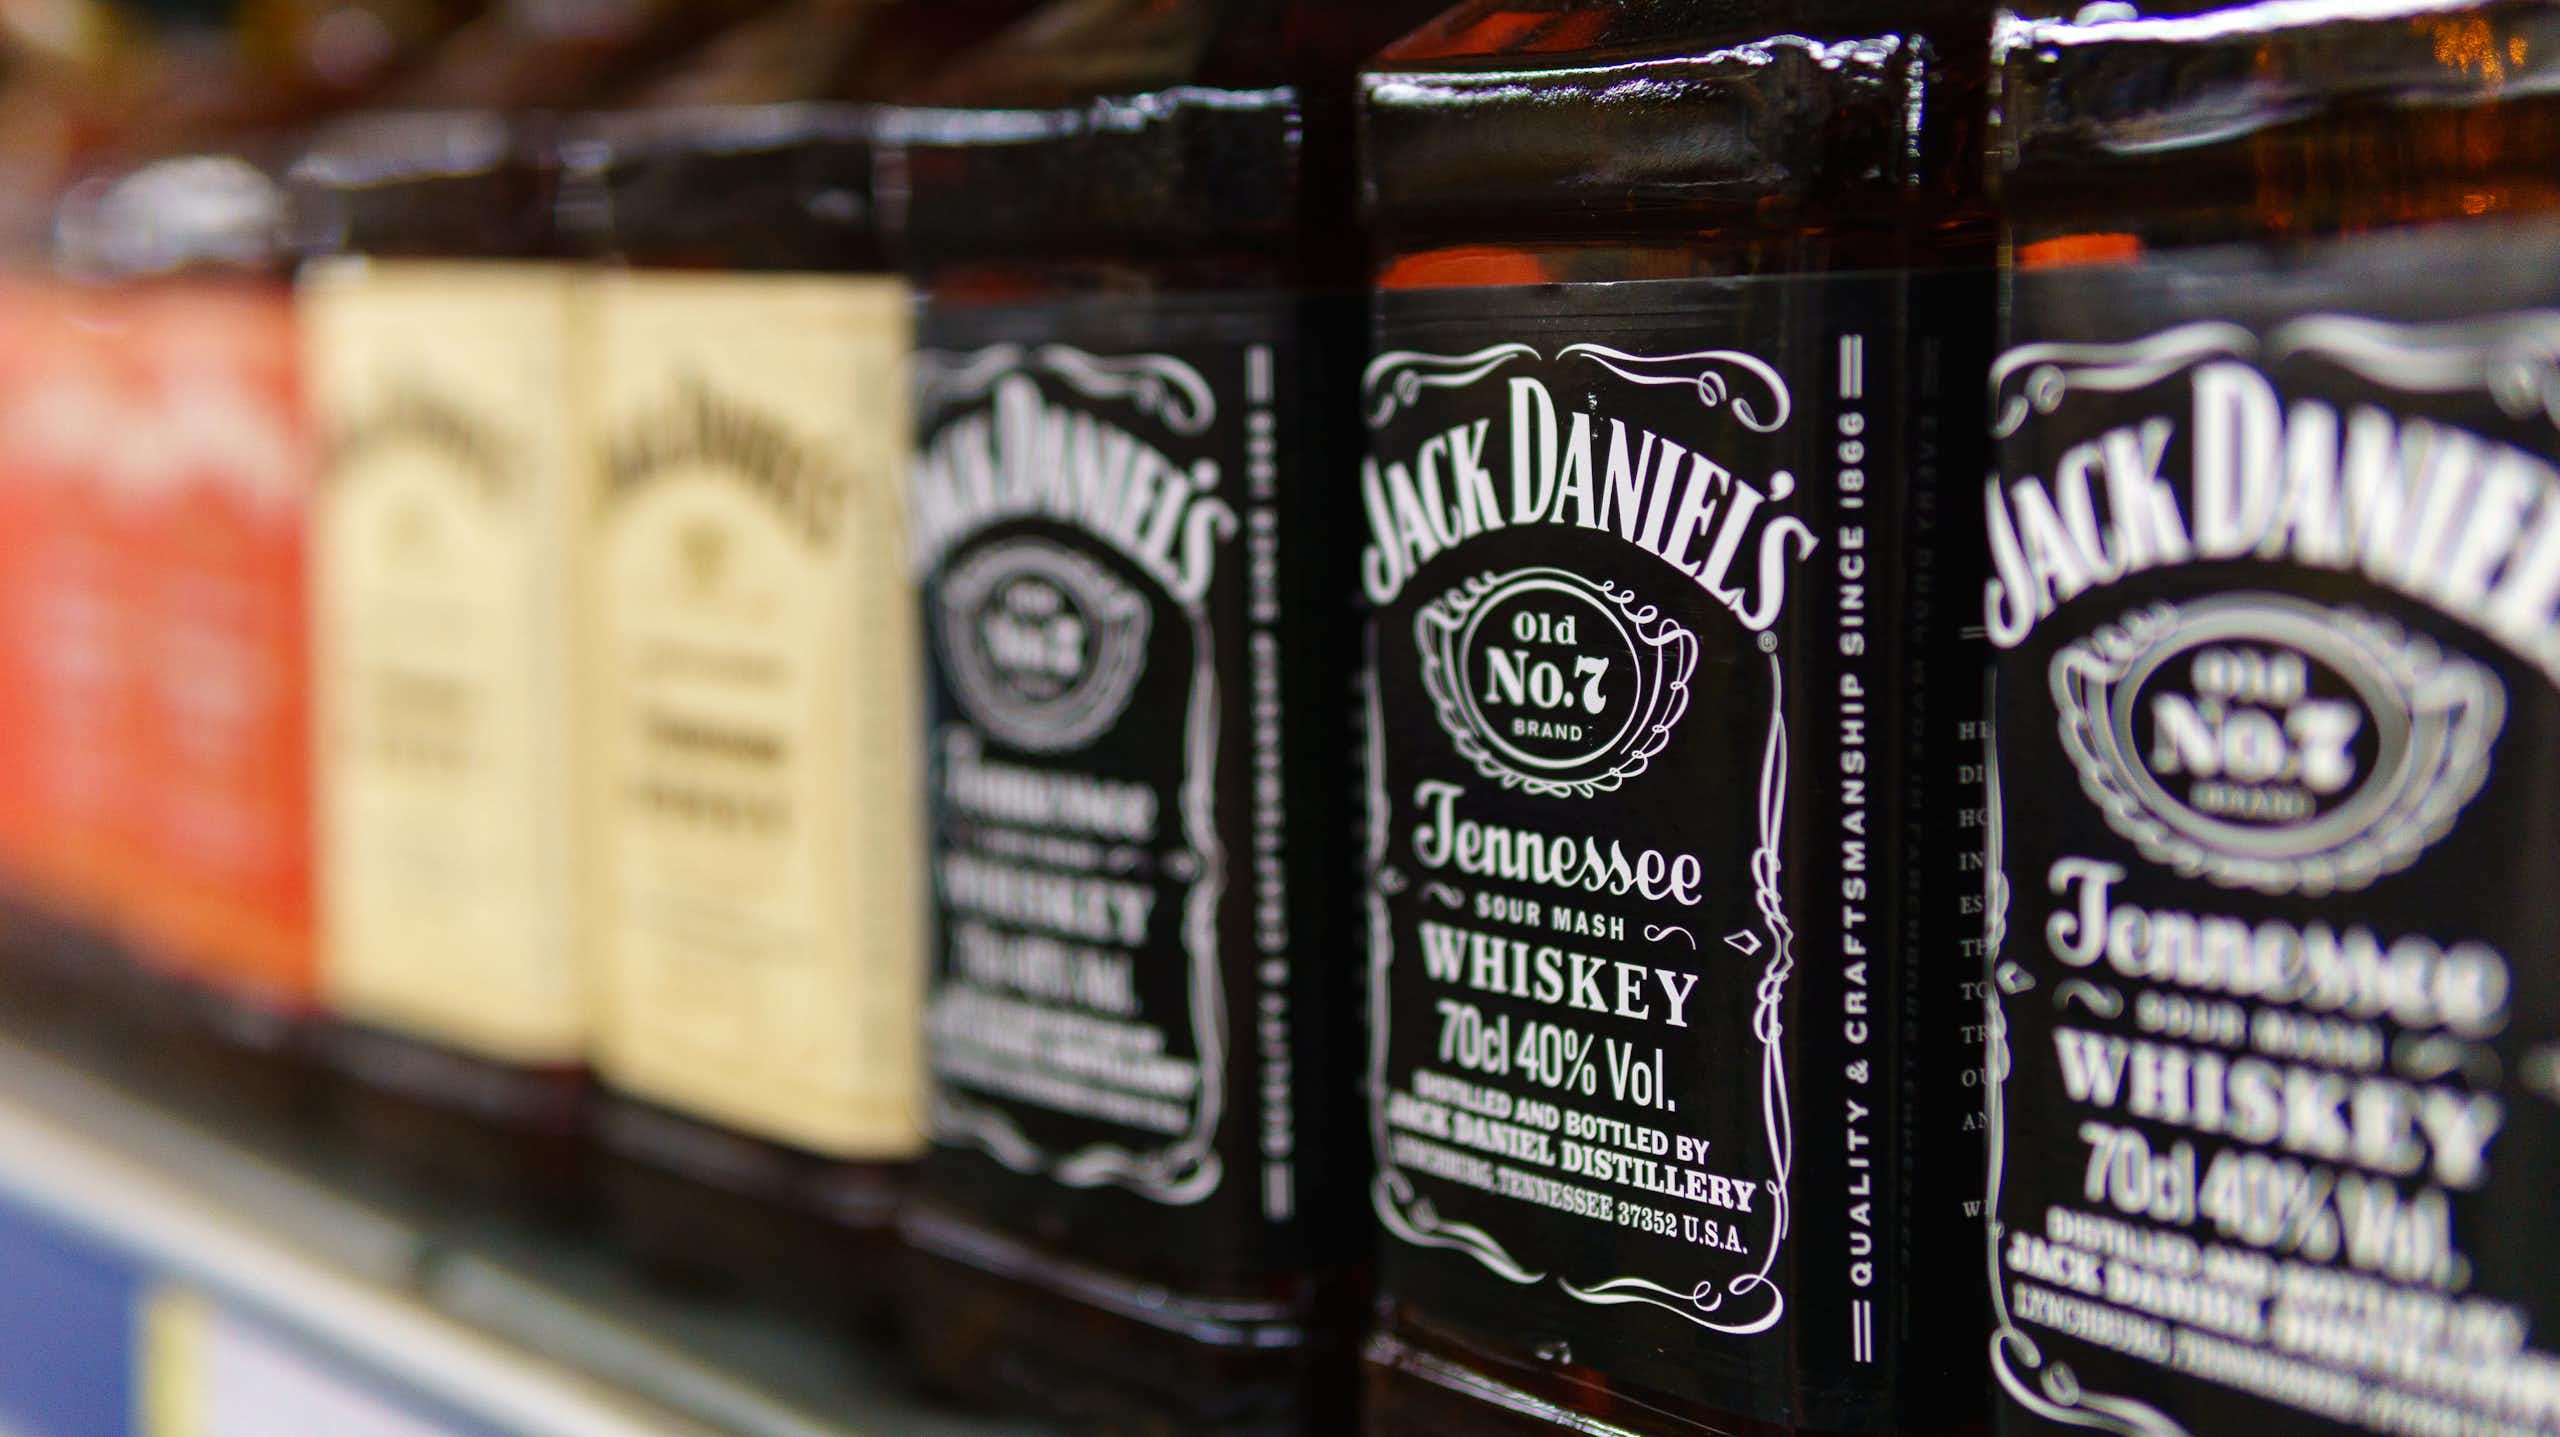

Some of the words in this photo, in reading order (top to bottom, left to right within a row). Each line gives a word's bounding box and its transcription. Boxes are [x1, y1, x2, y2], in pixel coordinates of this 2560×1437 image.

[1362, 417, 1506, 606] JACK
[1508, 377, 1820, 631] DANIEL'S
[1837, 411, 1866, 509] 1866
[1984, 415, 2197, 649] JACK
[1512, 610, 1578, 645] Old
[1838, 525, 1866, 657] SINCE
[1484, 645, 1610, 715] No.7
[1512, 717, 1583, 742] BRAND
[1412, 779, 1702, 906] Tennessee
[1839, 673, 1870, 1045] CRAFTSMANSHIP
[1474, 891, 1541, 927] SOUR
[1552, 905, 1625, 941] MASH
[2046, 856, 2509, 1041] Tennessee
[1417, 919, 1699, 1028] WHISKEY
[1435, 998, 1511, 1077] 70cl
[1514, 1020, 1598, 1097] 40%
[1605, 1037, 1677, 1113] Vol.
[1846, 1059, 1870, 1084] &
[2053, 1023, 2503, 1190] WHISKEY
[1453, 1111, 1557, 1167] DANIEL
[1559, 1139, 1758, 1214] DISTILLERY
[1514, 1097, 1561, 1132] AND
[1564, 1109, 1670, 1156] BOTTLED
[1675, 1134, 1711, 1166] BY
[1496, 1165, 1614, 1222] TENNESSEE
[1617, 1200, 1679, 1239] 37352
[1682, 1214, 1749, 1255] U.S.A.
[1847, 1099, 1873, 1288] QUALITY
